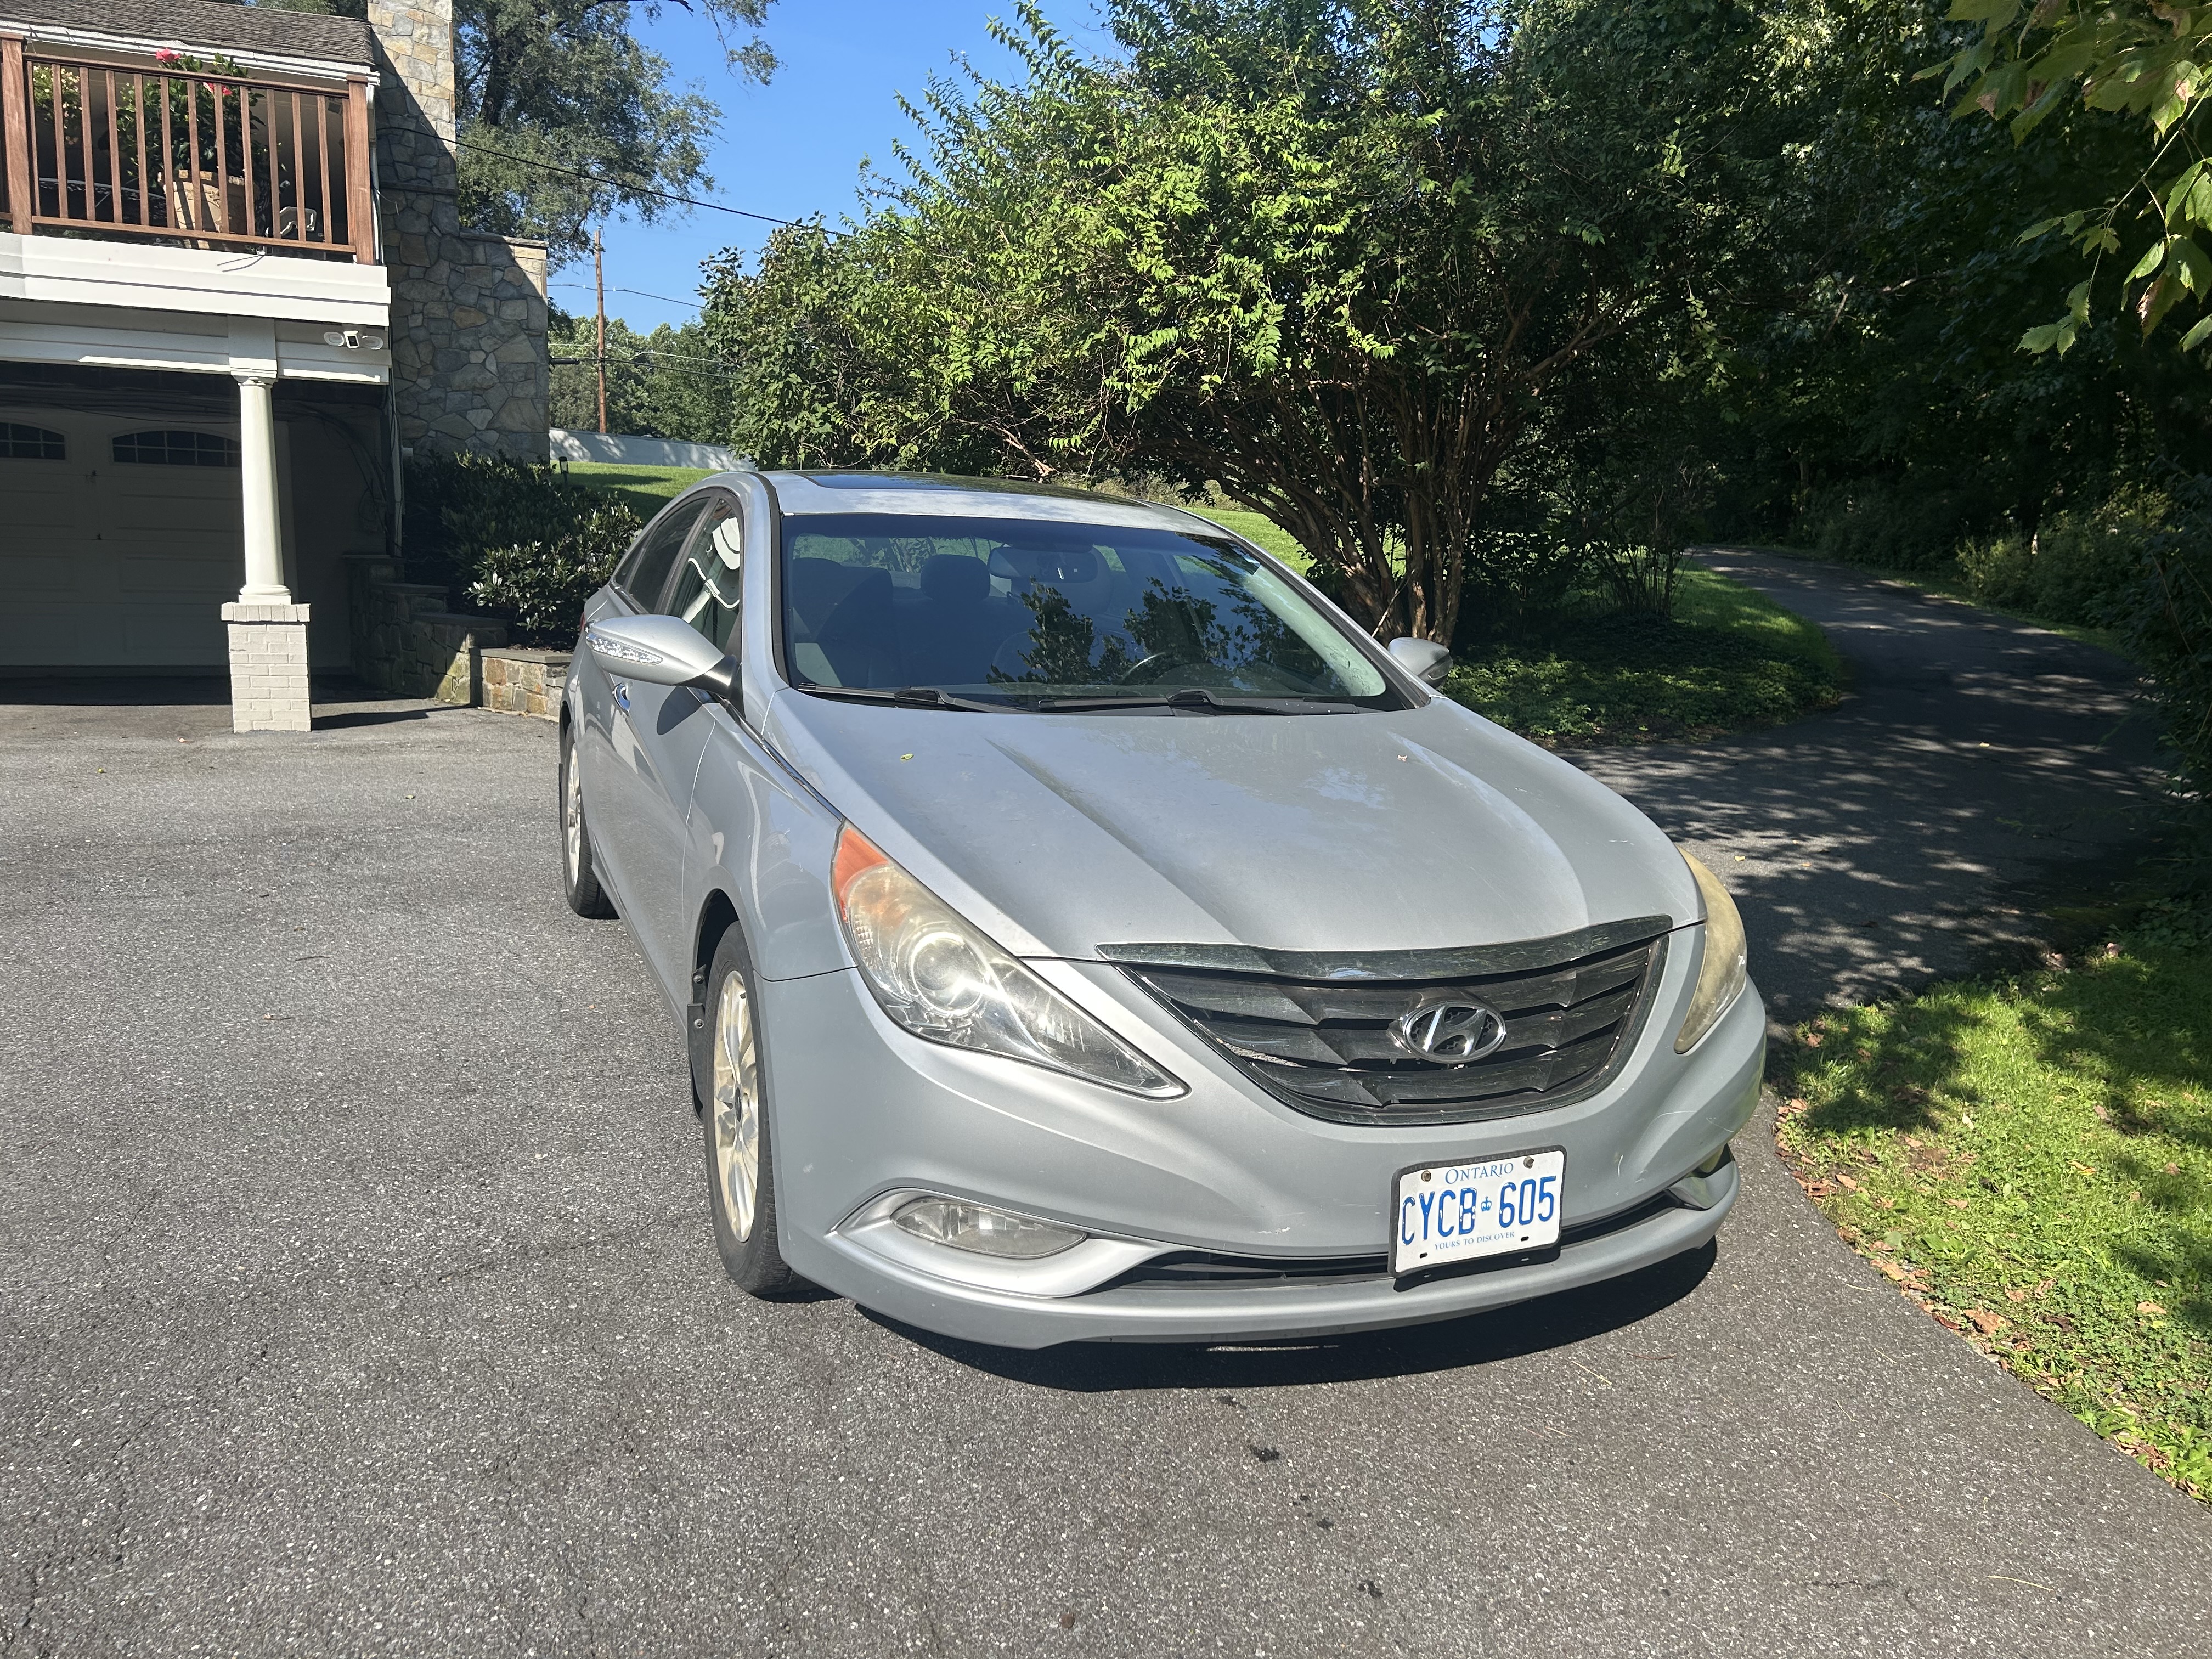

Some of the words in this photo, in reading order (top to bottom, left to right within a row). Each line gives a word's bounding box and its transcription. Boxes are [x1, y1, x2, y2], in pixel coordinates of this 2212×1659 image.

[1445, 1163, 1514, 1184] ONTARIO
[1402, 1187, 1477, 1245] CYCB
[1499, 1176, 1556, 1228] 605
[1434, 1240, 1460, 1250] YOURS
[1464, 1237, 1474, 1245] TO
[1476, 1231, 1515, 1243] DISCOVER
